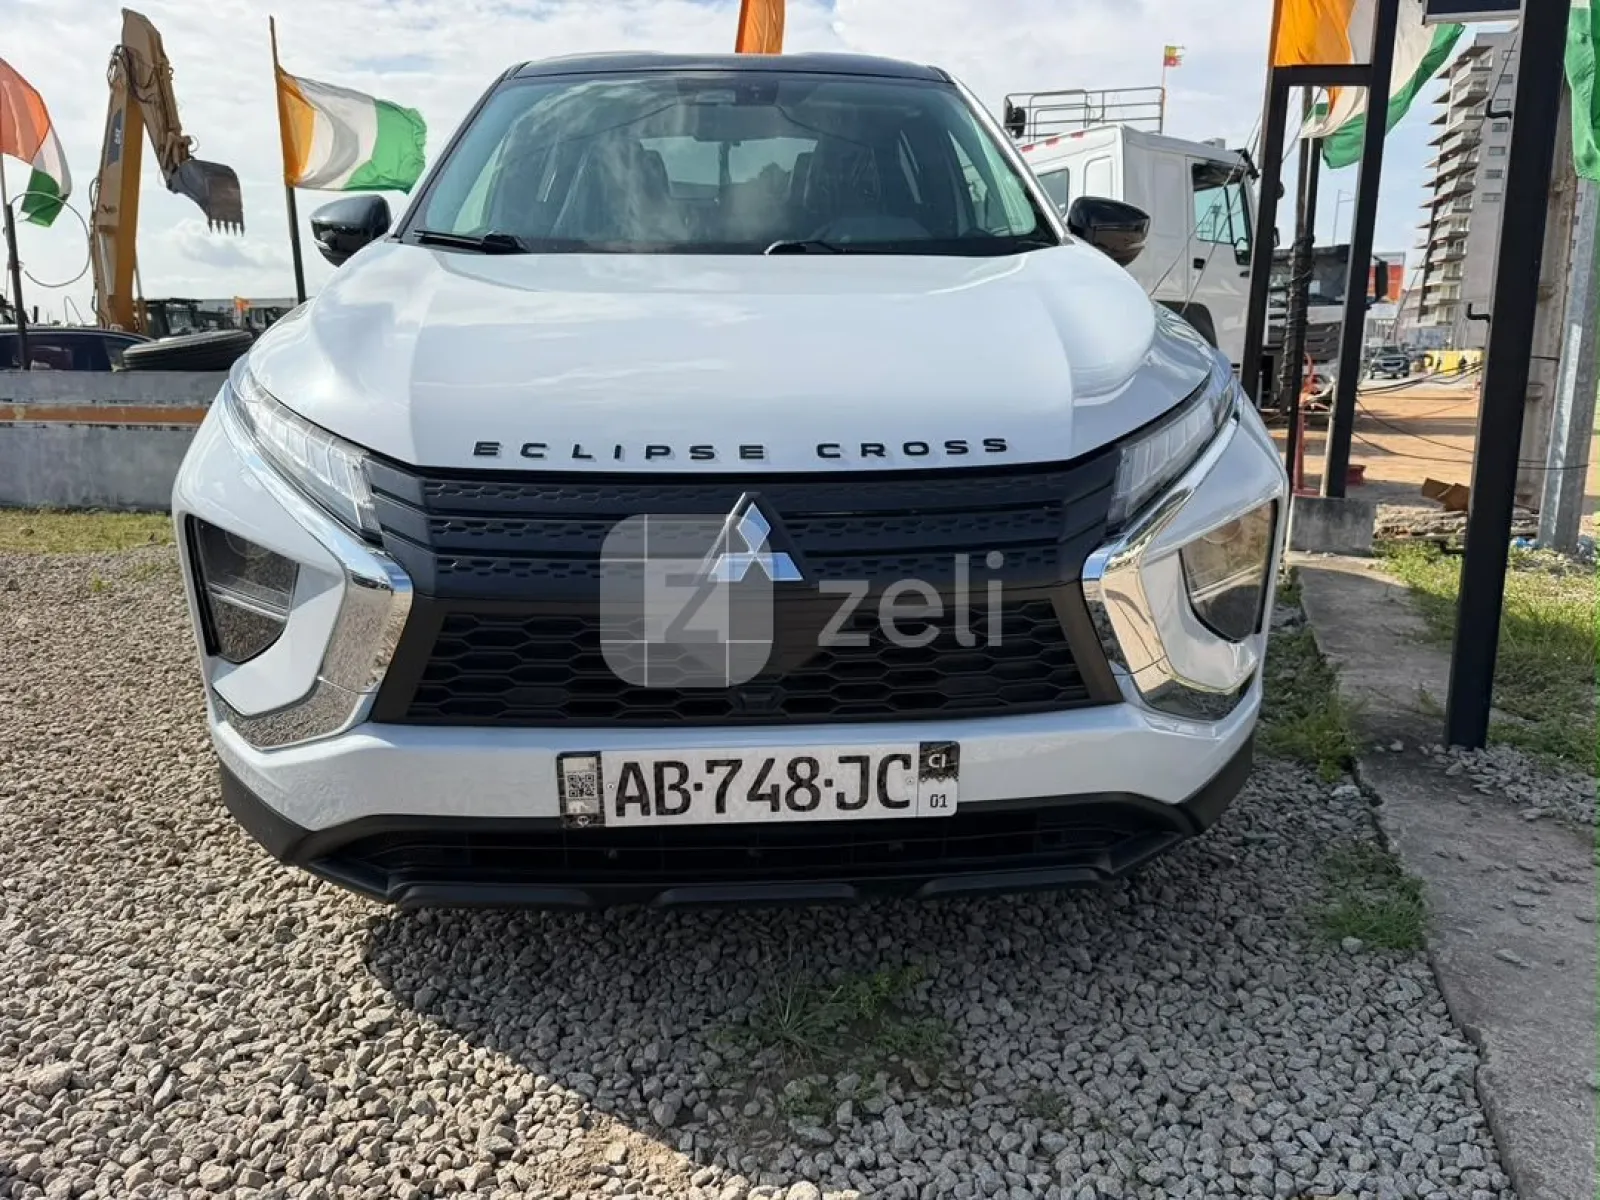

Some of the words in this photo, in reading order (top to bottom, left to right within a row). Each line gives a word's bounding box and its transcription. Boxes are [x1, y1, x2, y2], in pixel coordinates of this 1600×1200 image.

[473, 440, 765, 461] ECLIPSE
[816, 438, 1009, 458] CROSS
[928, 753, 946, 768] CI
[929, 793, 948, 808] 01
